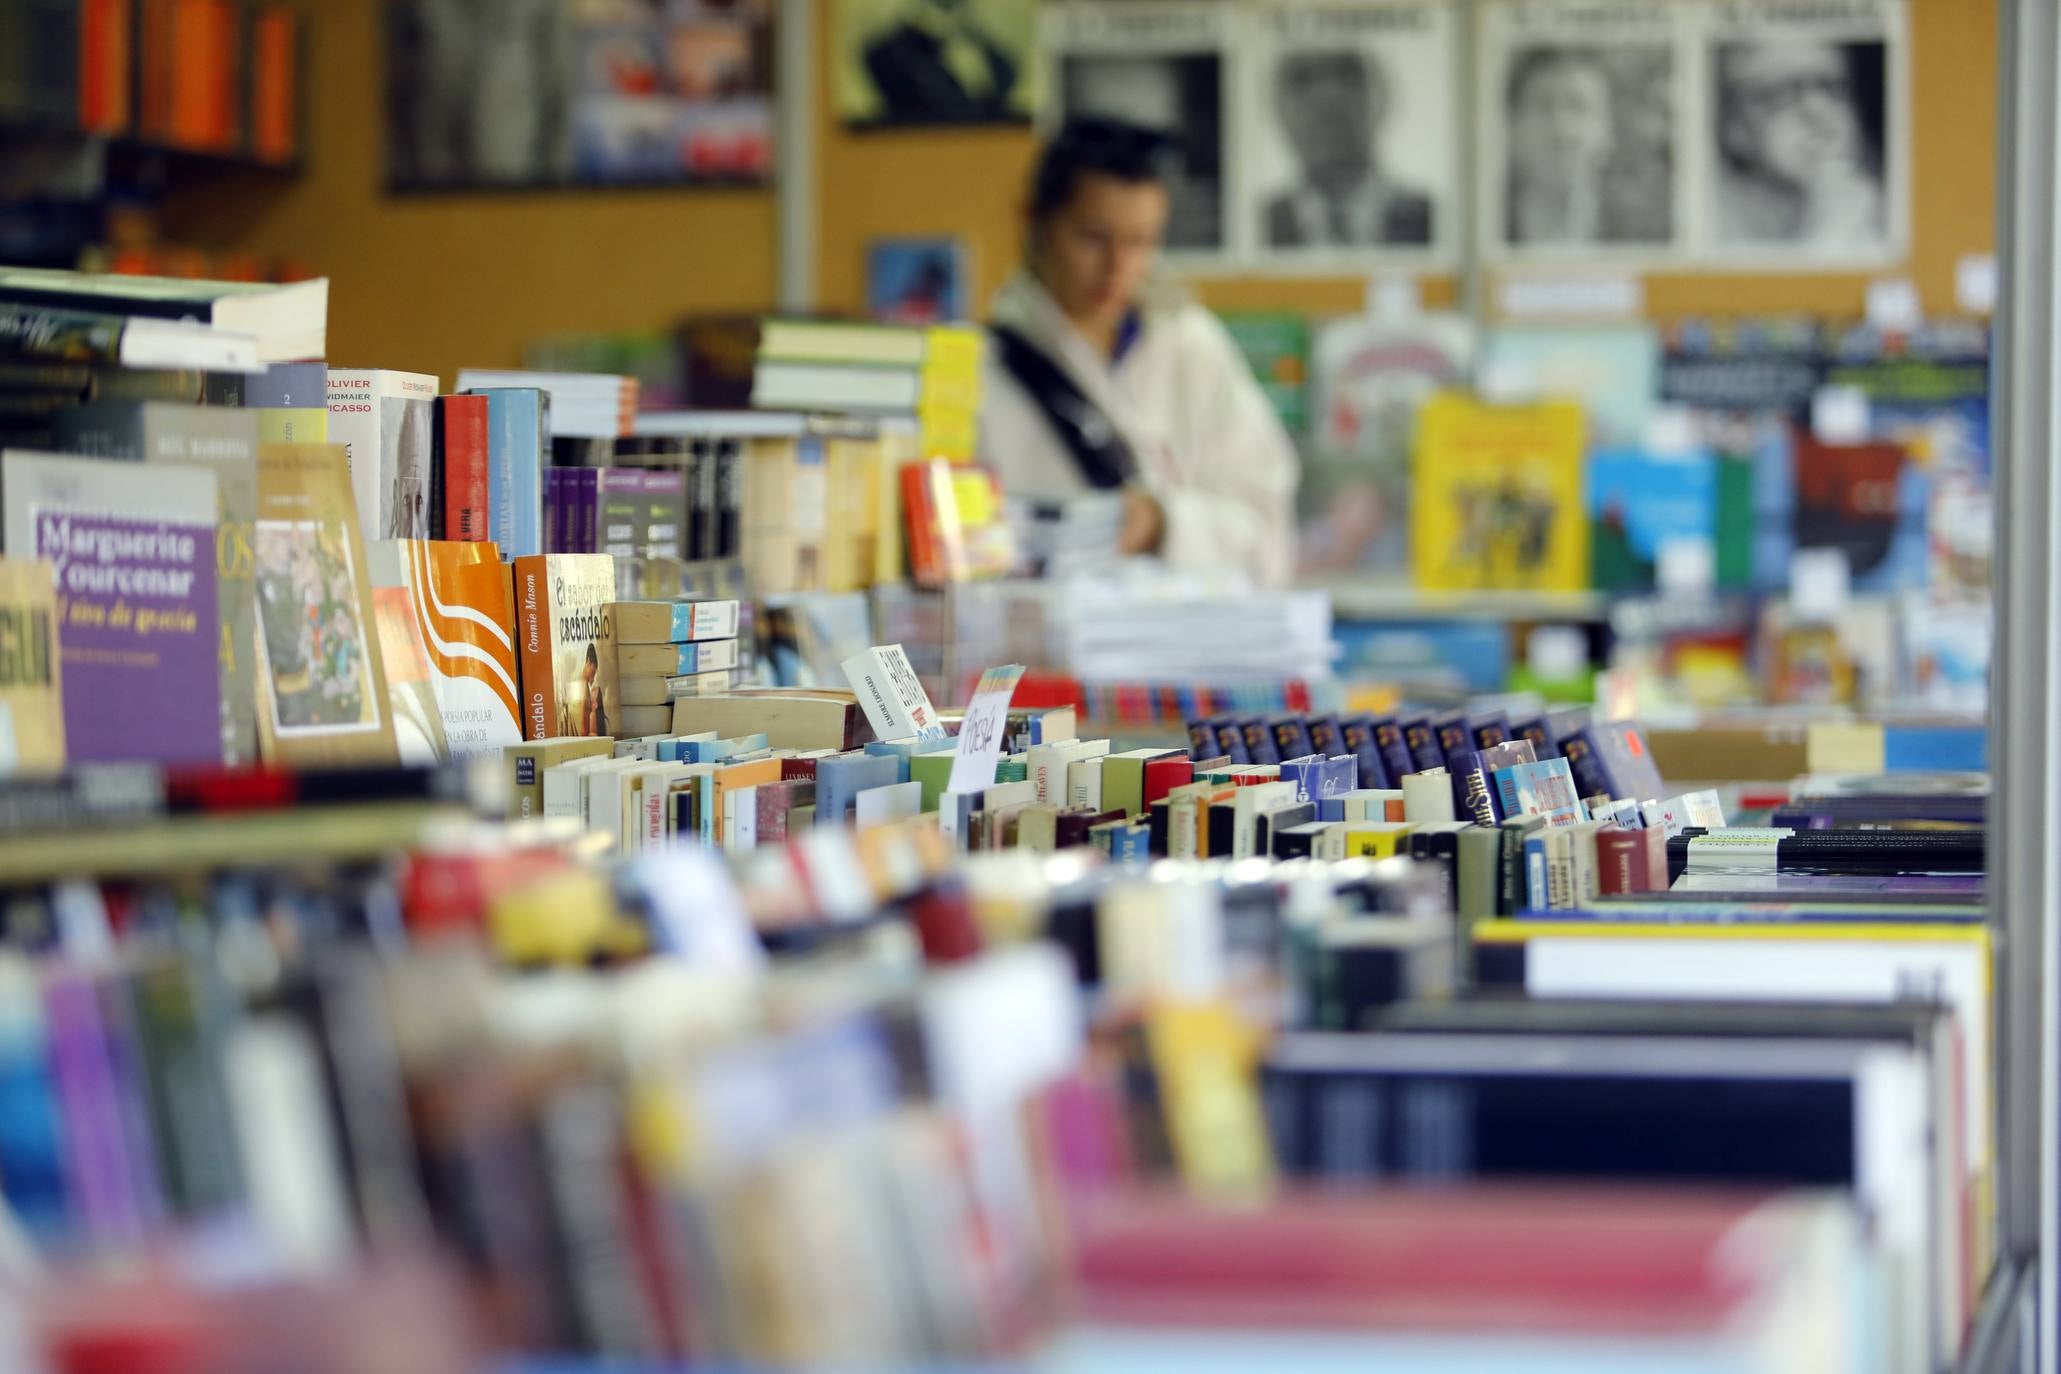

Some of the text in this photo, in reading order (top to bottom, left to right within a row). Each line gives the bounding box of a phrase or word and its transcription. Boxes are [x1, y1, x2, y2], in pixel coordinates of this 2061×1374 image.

[284, 394, 290, 405] 2
[327, 404, 371, 412] ICASSO
[42, 516, 195, 563] Marguerite
[461, 508, 471, 533] VERA
[53, 553, 195, 596] Yourcenar
[108, 598, 132, 630] de
[135, 604, 197, 635] gracia
[525, 573, 539, 654] Connie Mason
[560, 606, 610, 645] escándalo
[532, 693, 545, 740] ándalo
[864, 675, 895, 728] ELMORE LEONARD
